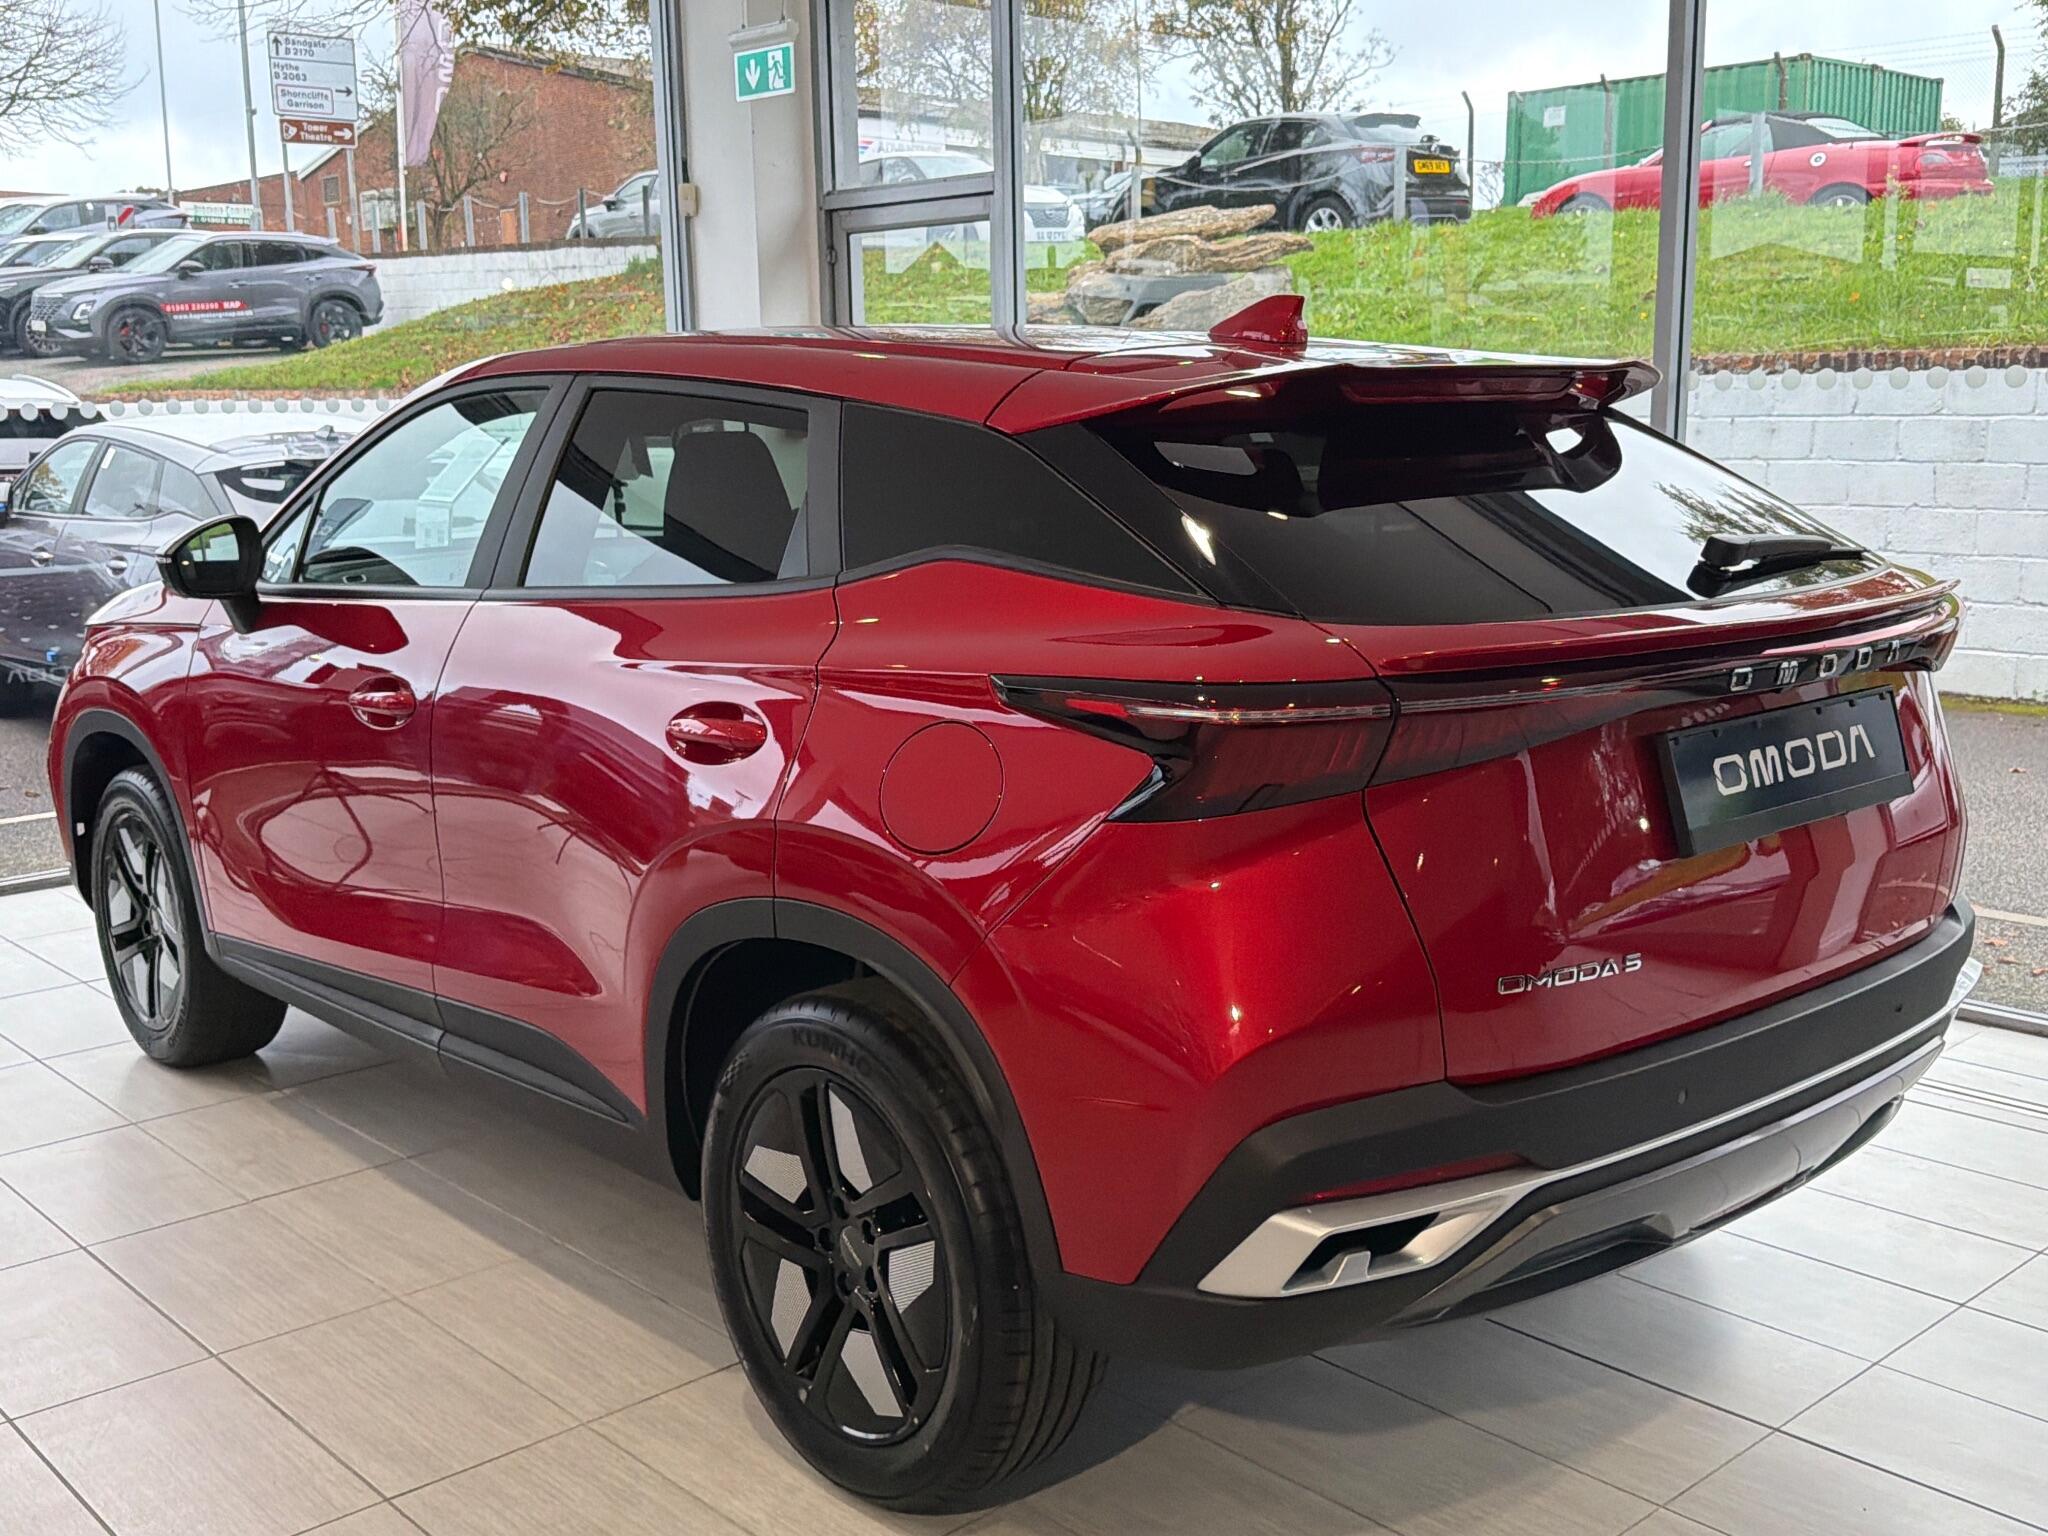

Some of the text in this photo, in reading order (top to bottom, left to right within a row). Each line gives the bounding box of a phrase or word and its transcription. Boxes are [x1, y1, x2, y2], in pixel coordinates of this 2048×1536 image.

[284, 37, 328, 49] Sandgate
[284, 48, 315, 57] B 2170
[273, 61, 300, 71] Hythe
[274, 71, 307, 81] B 2063
[280, 88, 329, 101] Shorncliffe
[287, 99, 325, 109] Garrison
[302, 122, 329, 132] Tower
[300, 131, 333, 142] Theatre
[1729, 639, 1901, 692] OMODA
[1712, 723, 1877, 797] OMODA
[1497, 952, 1643, 996] OMODA 5
